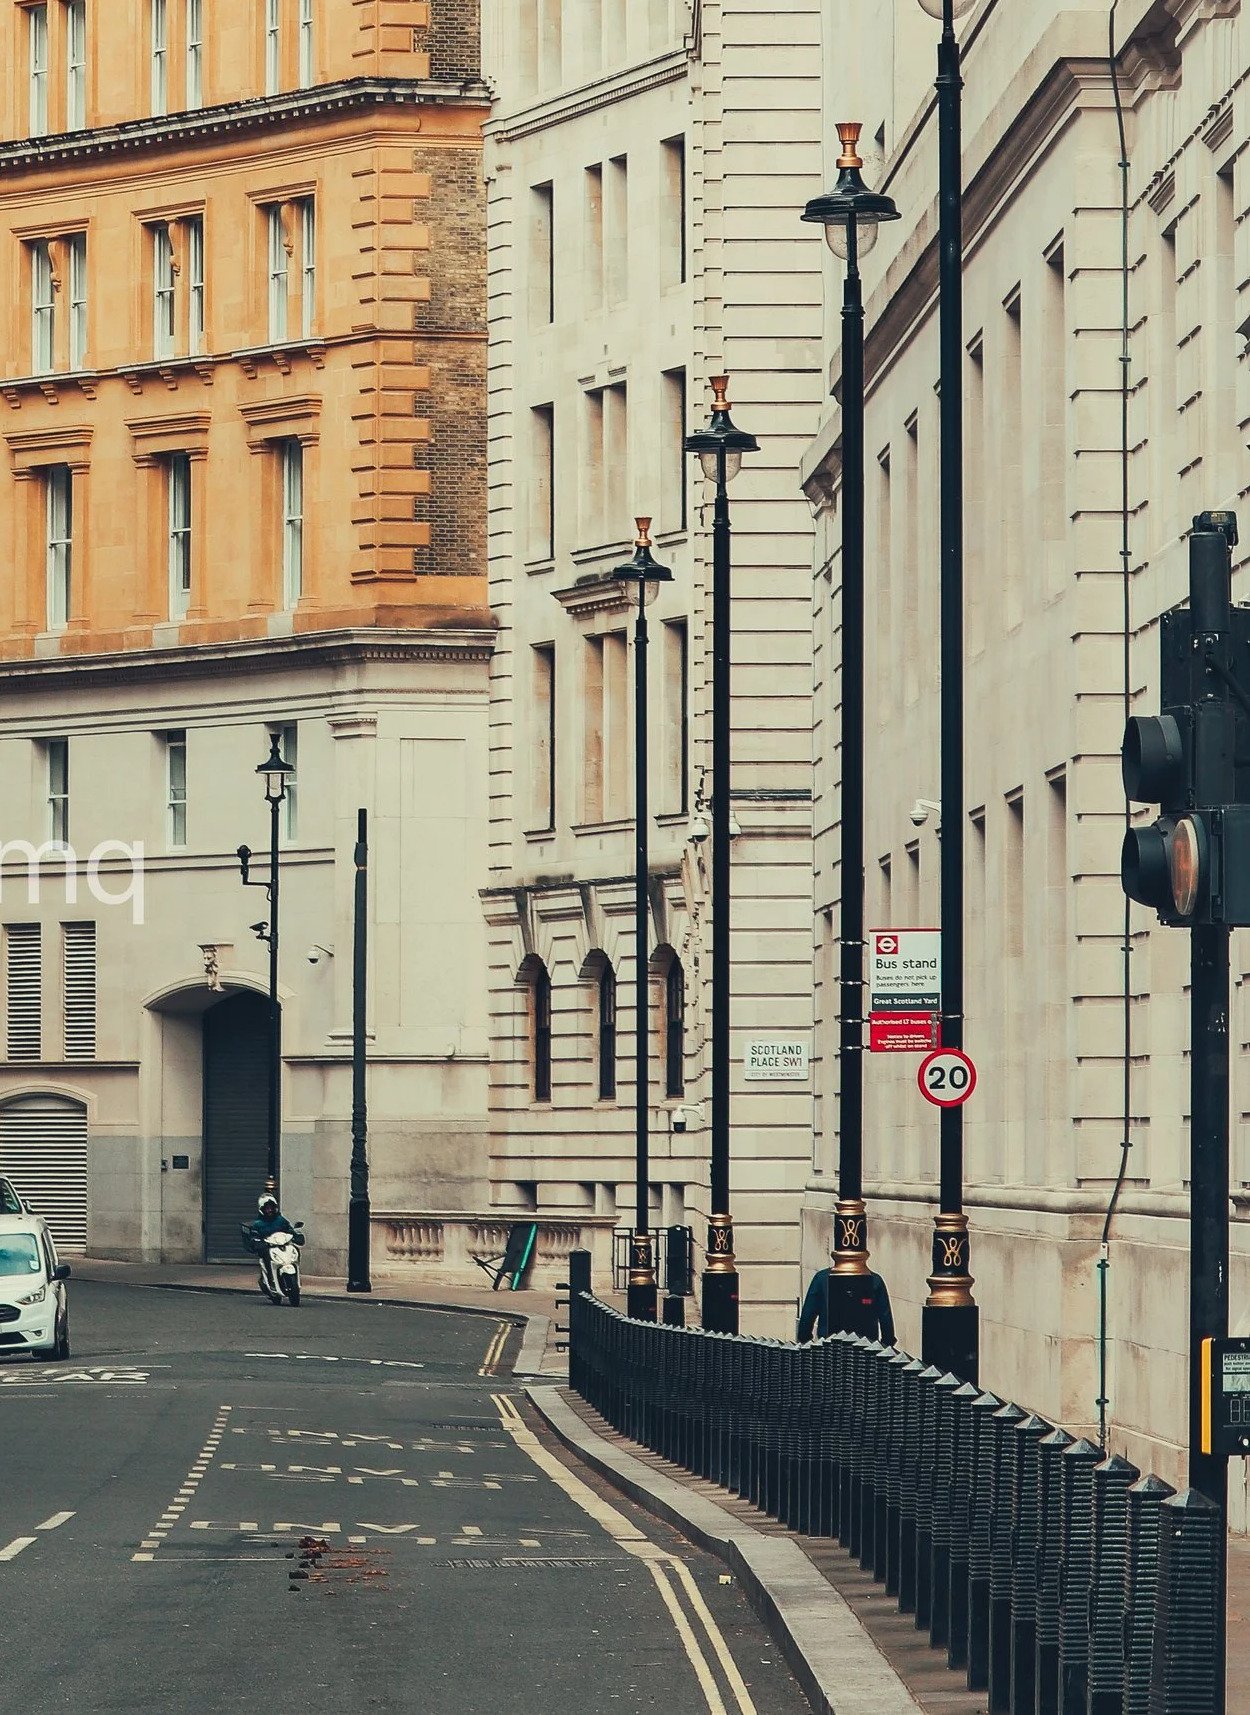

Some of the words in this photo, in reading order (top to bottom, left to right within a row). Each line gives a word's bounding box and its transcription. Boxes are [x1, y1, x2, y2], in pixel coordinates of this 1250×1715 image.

[876, 958, 898, 969] Bus
[902, 957, 937, 969] stand
[751, 1045, 802, 1055] SCOTLAND
[751, 1057, 780, 1067] PLACE
[783, 1057, 802, 1067] SW1
[928, 1065, 968, 1090] 20
